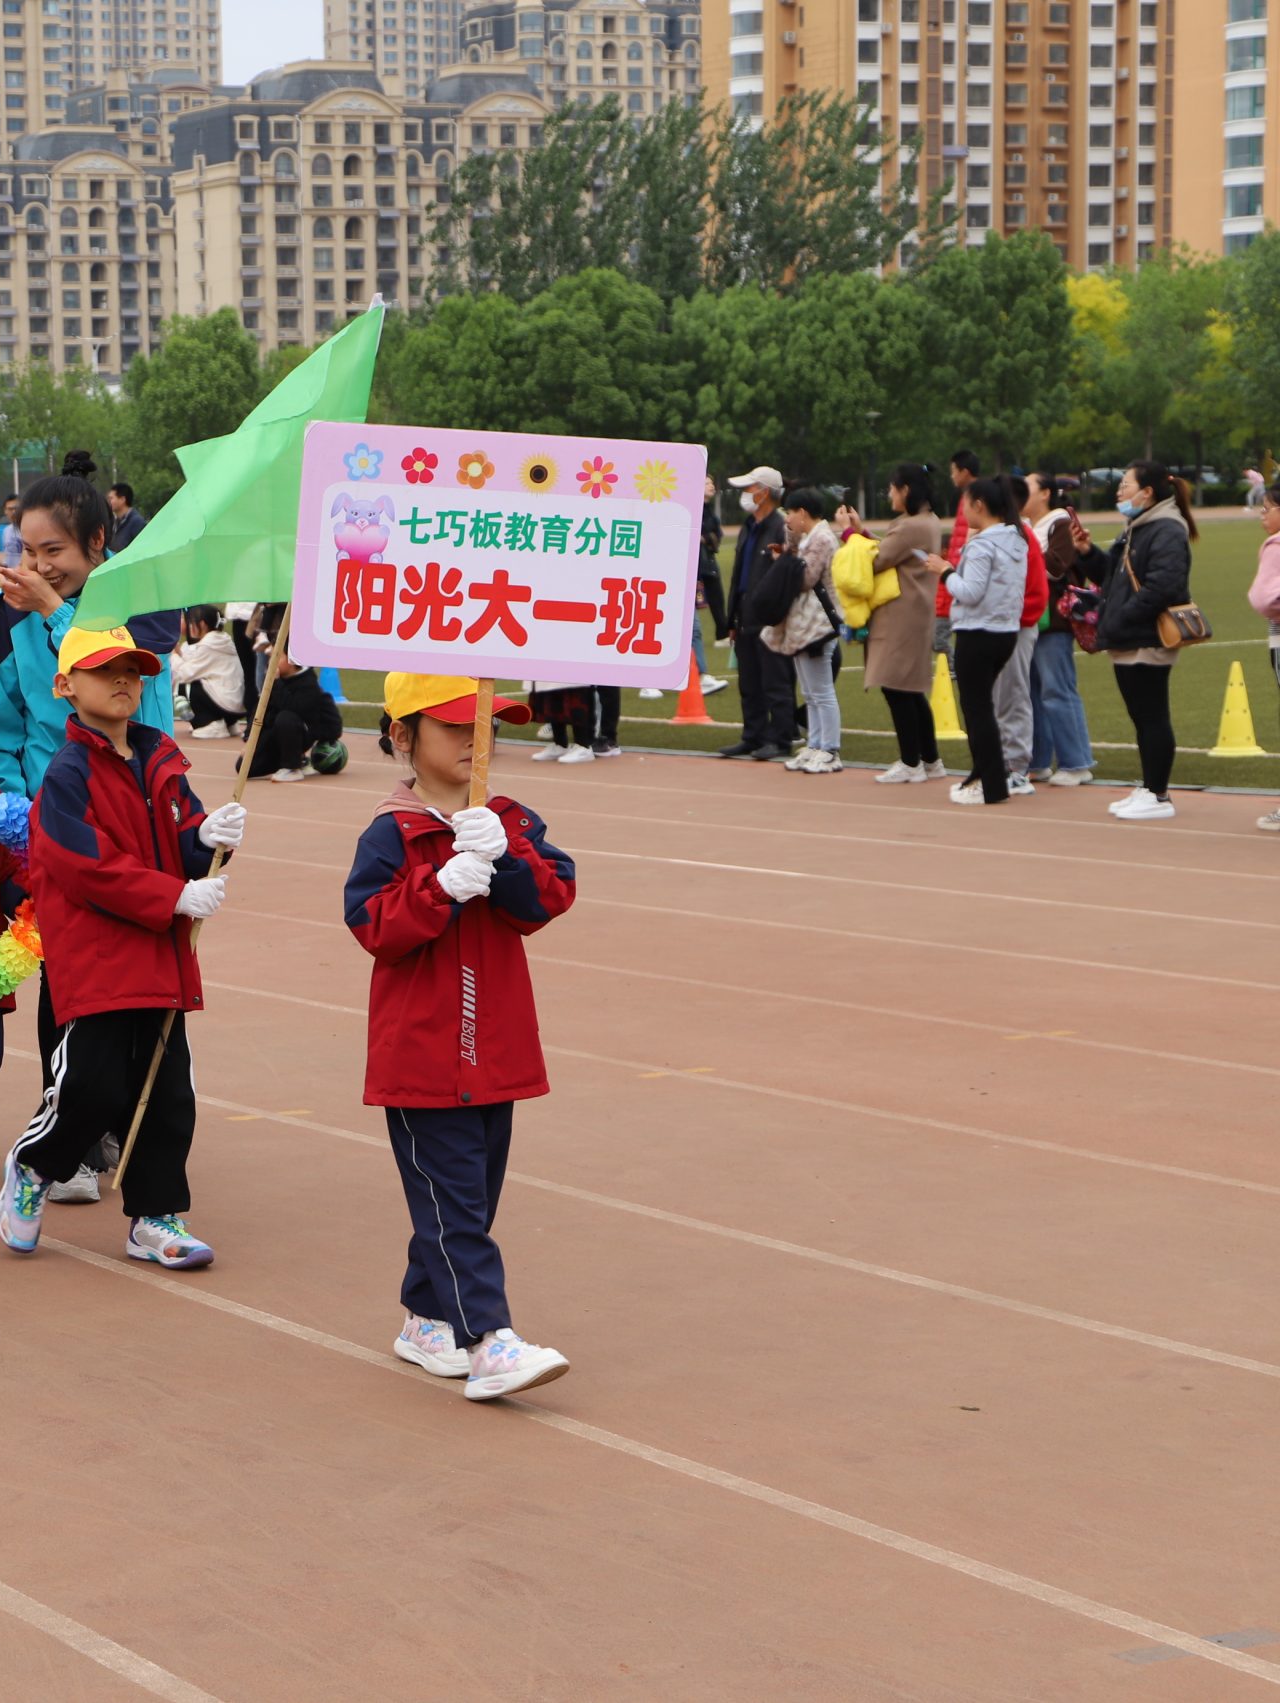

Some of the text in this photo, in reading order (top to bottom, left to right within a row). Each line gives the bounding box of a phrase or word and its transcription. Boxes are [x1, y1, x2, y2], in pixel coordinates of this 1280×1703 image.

[399, 507, 643, 558] 七巧板教育分园
[333, 559, 667, 655] 阳光大一班
